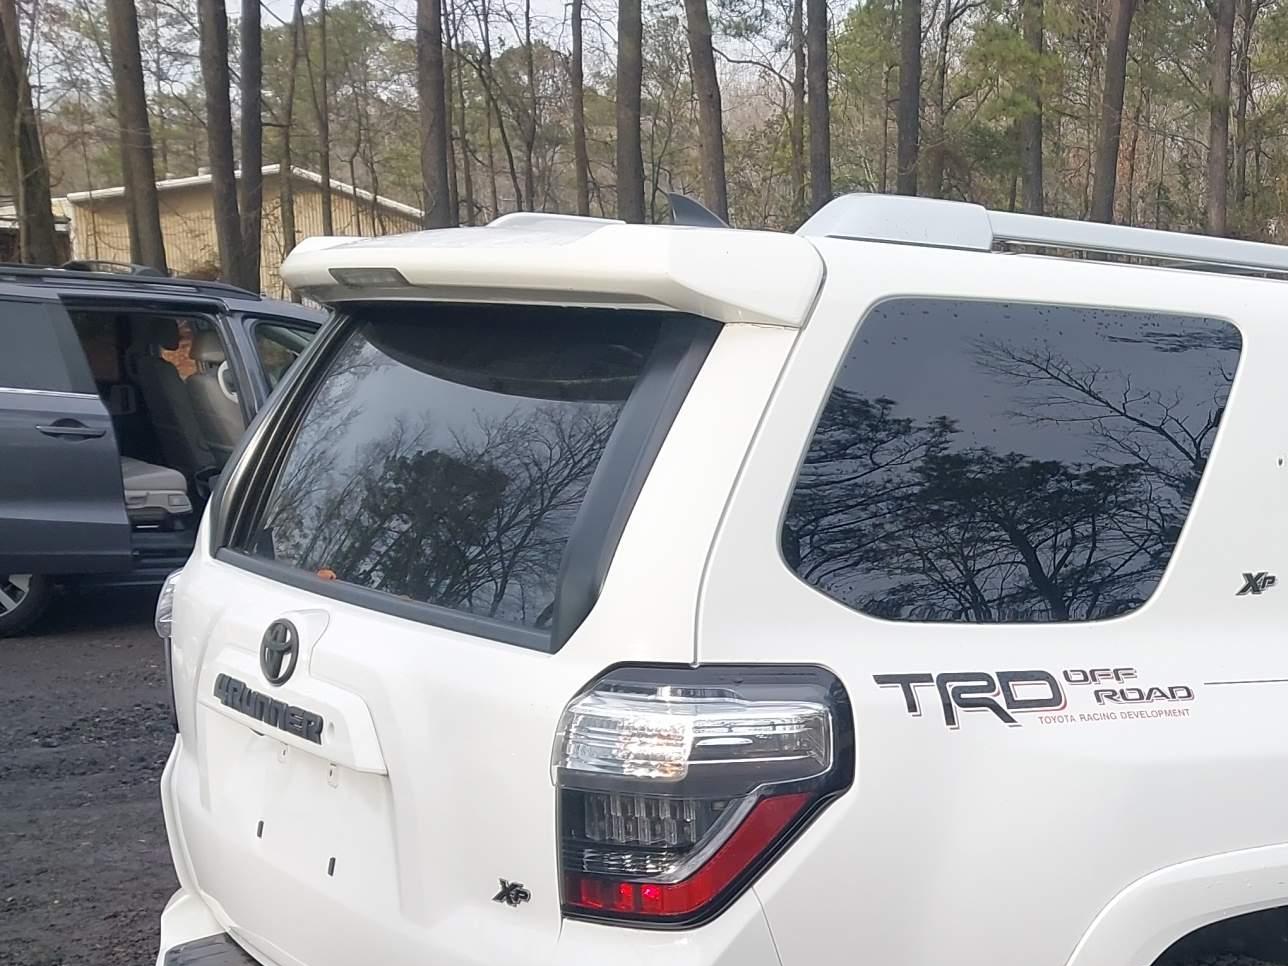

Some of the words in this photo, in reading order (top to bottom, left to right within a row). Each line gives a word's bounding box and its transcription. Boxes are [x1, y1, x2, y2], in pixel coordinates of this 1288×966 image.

[1062, 667, 1138, 685] OFF
[872, 670, 1067, 730] TRD
[1093, 685, 1195, 705] ROAD
[1038, 715, 1076, 725] TOYOTA
[1079, 712, 1118, 722] RACING
[1120, 709, 1190, 720] DEVELOPMENT
